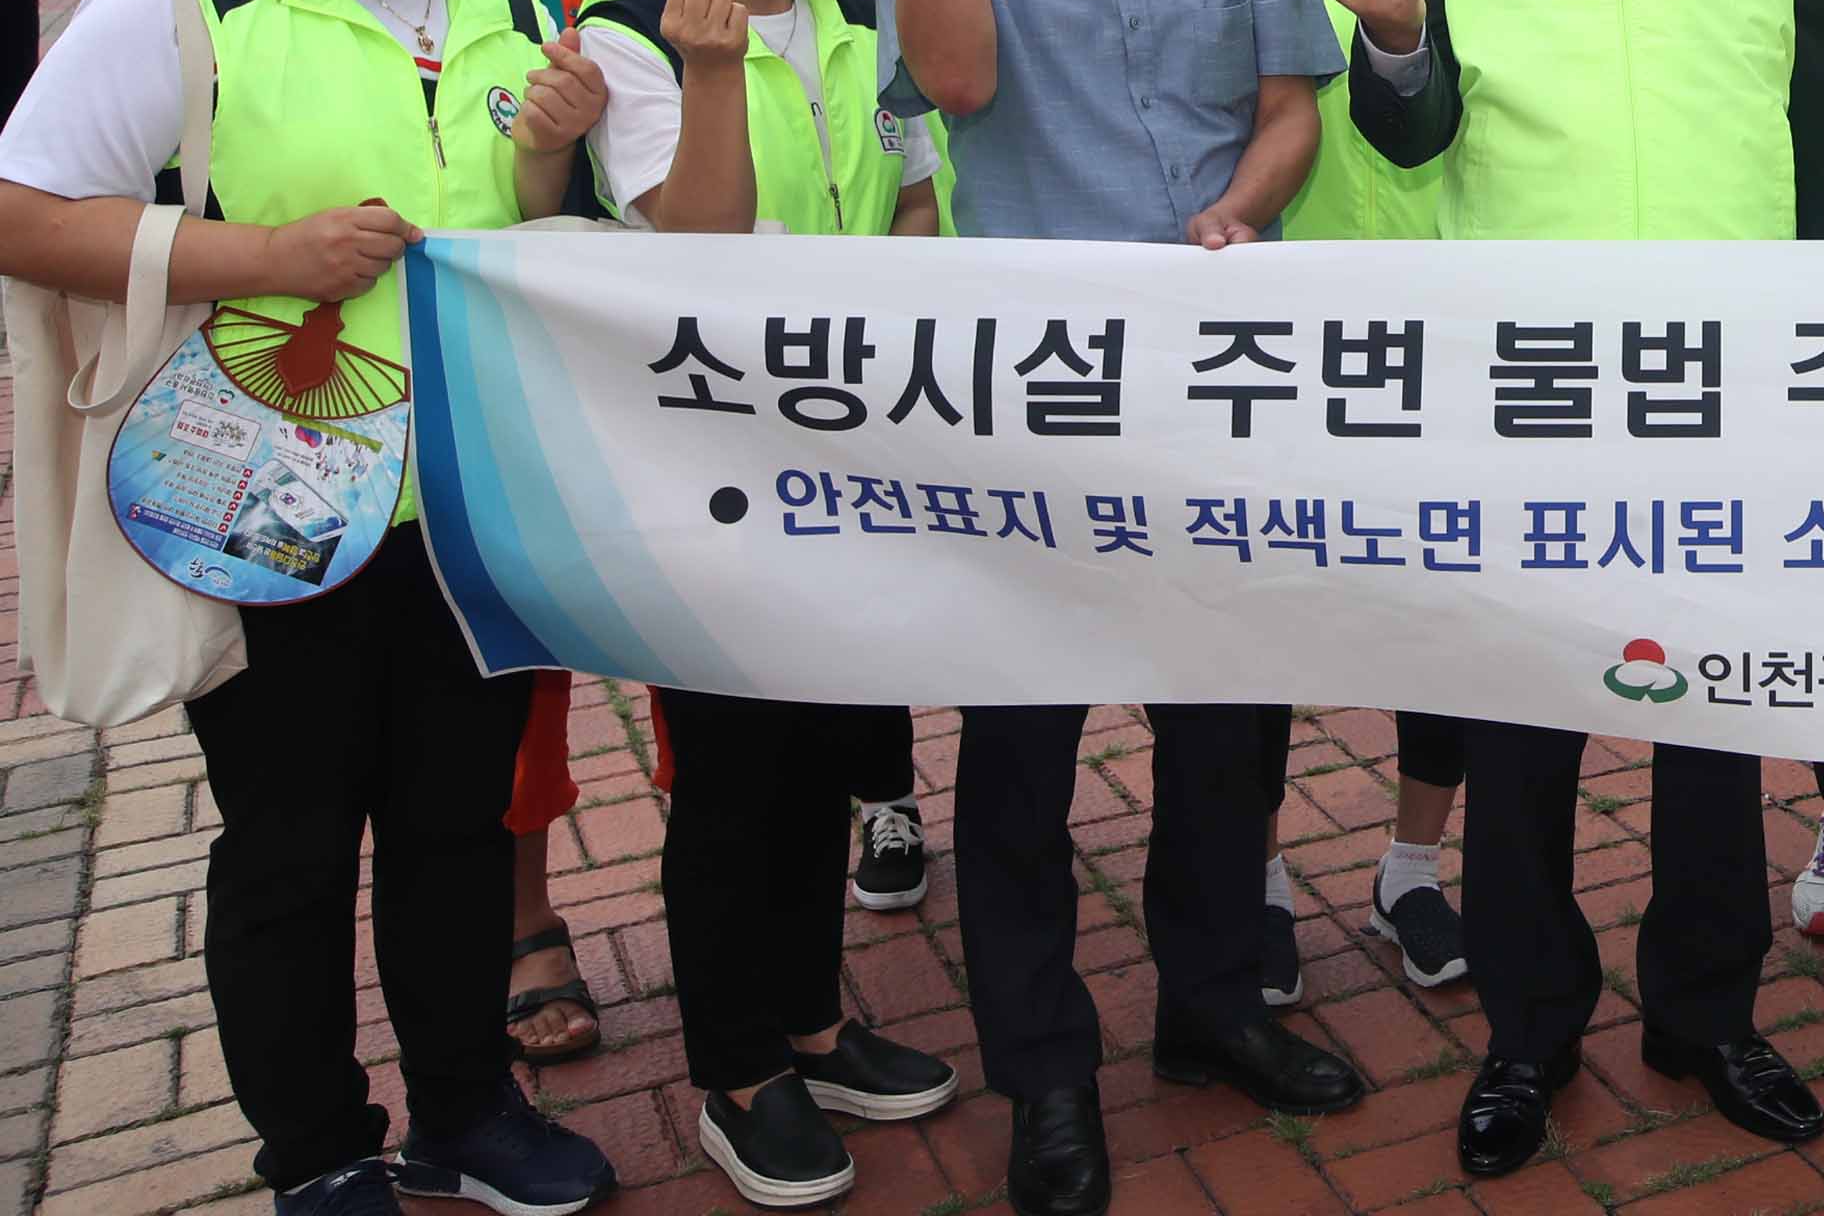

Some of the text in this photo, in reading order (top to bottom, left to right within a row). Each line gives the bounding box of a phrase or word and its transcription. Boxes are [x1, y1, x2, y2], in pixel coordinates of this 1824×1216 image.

[647, 316, 1125, 437] 소방시설
[1187, 319, 1425, 439] 주변
[1489, 320, 1722, 439] 불법
[775, 469, 1057, 549] 안전표지
[1085, 495, 1154, 557] 및
[1185, 497, 1481, 573] 적색노면
[1520, 499, 1744, 574] 표시된
